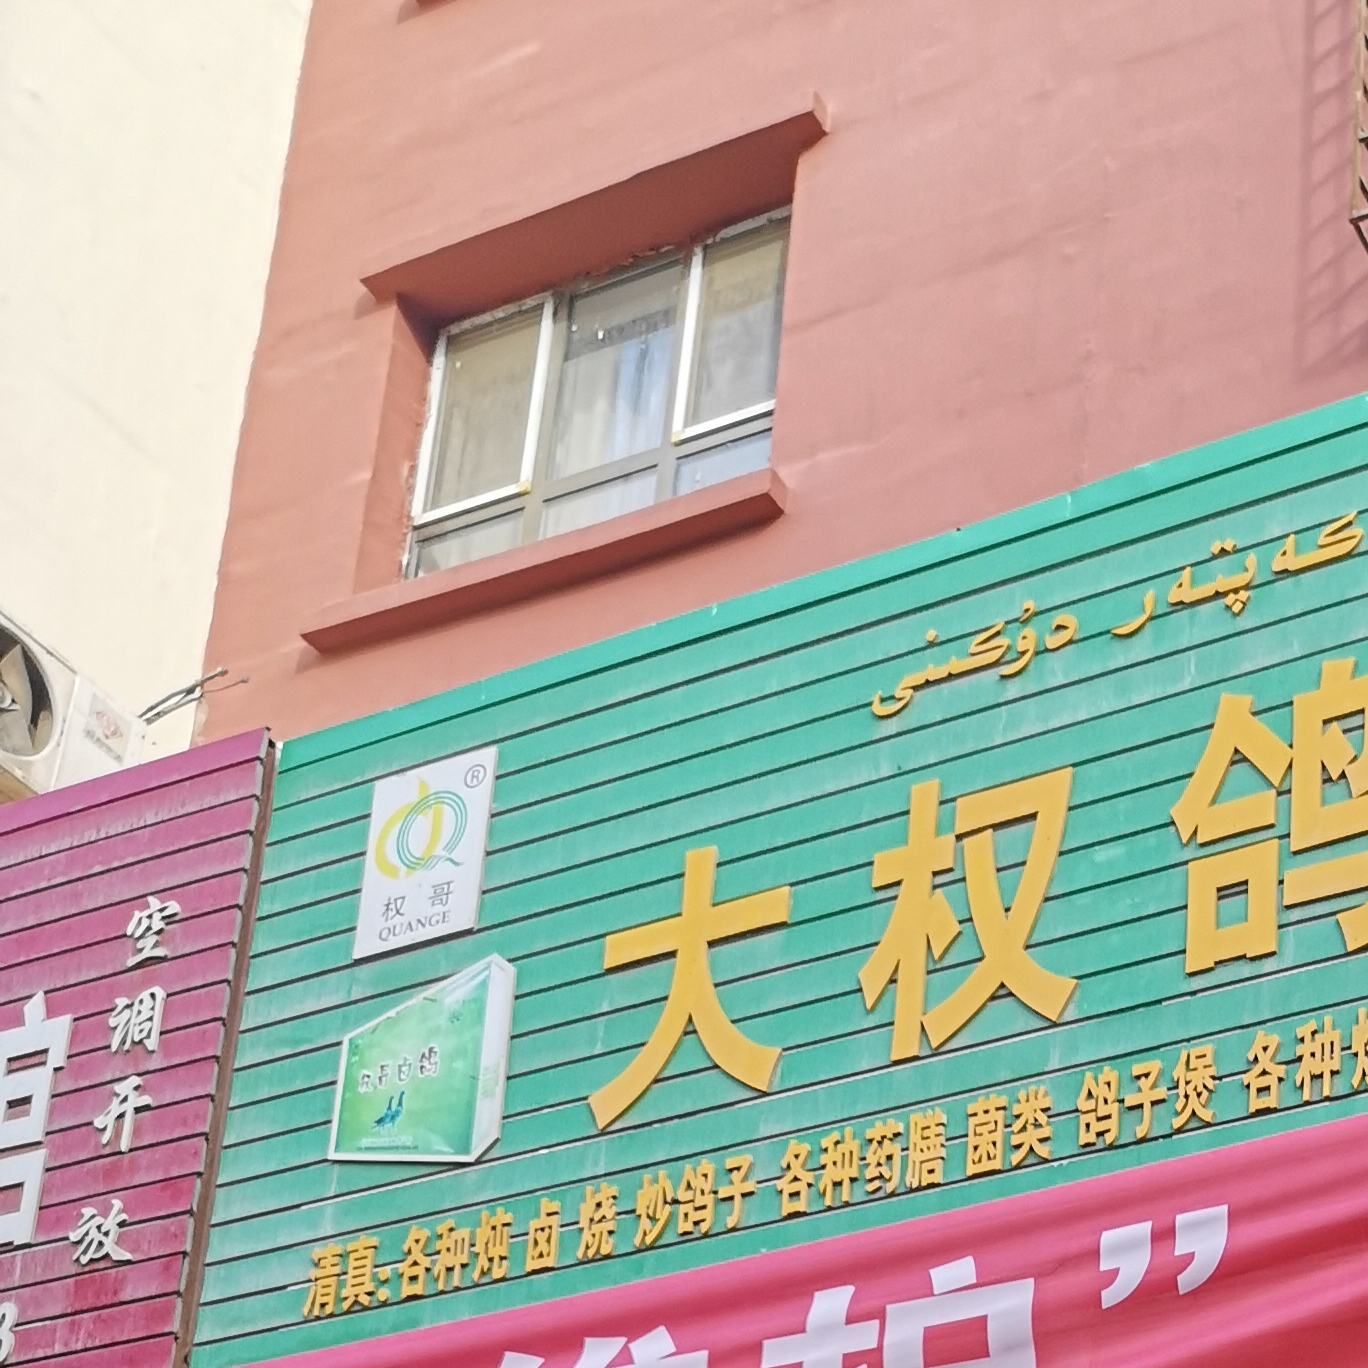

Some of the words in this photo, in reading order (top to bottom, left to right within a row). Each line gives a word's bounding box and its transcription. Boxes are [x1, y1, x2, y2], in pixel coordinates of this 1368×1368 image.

[382, 880, 454, 923] 权哥
[378, 910, 451, 942] QUANGE
[525, 1198, 560, 1272] 卤
[578, 1182, 618, 1261] 烧
[634, 1153, 757, 1250] 炒鸽子
[775, 1107, 948, 1218] 各种药膳
[965, 1085, 1053, 1178] 菌类
[1077, 1044, 1217, 1147] 鸽子煲
